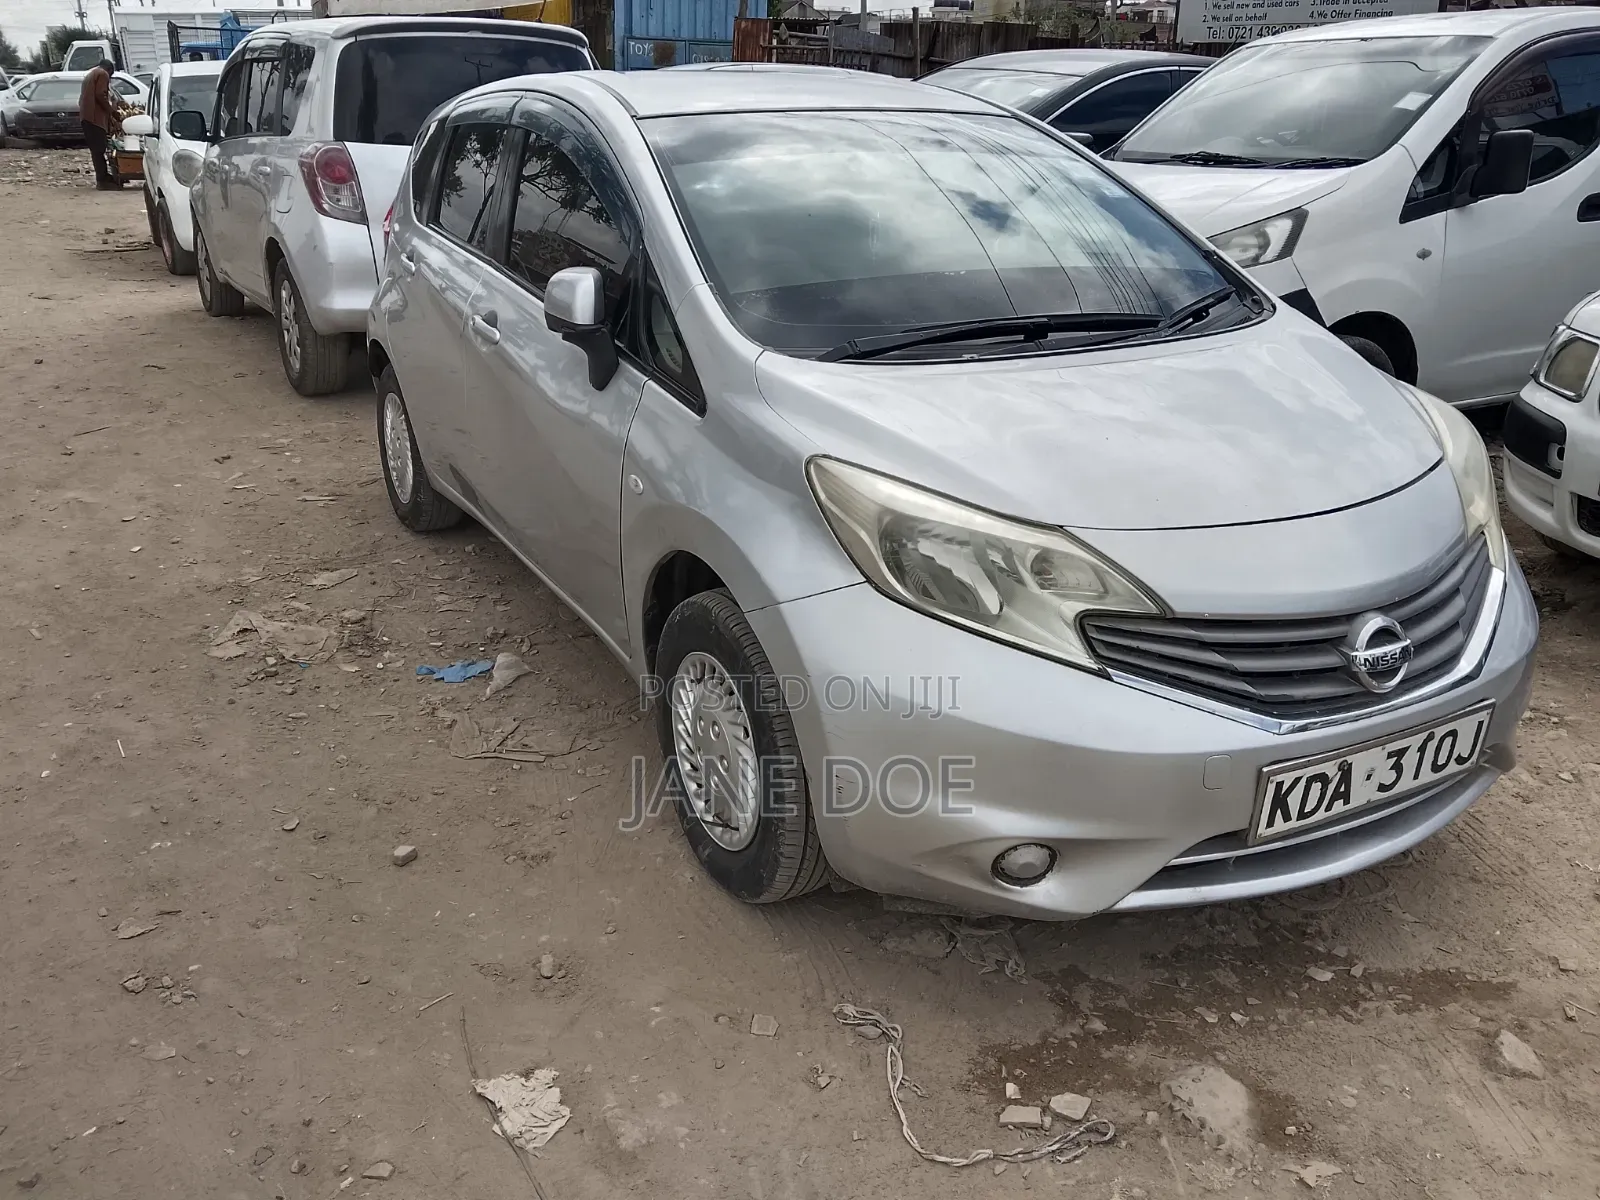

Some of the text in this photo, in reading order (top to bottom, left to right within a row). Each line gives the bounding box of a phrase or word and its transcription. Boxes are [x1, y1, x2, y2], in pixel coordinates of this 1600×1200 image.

[1212, 1, 1222, 10] We
[1223, 1, 1234, 9] sell
[1252, 0, 1265, 9] and
[1267, 0, 1283, 8] used
[1202, 15, 1210, 23] 2.
[1210, 14, 1221, 23] We
[1222, 14, 1233, 22] sell
[1245, 12, 1268, 22] behalf
[1330, 9, 1351, 19] Offer
[1207, 26, 1225, 40] Tel:
[1228, 26, 1253, 40] 0721
[1363, 644, 1413, 669] NISSAN
[1264, 719, 1485, 831] KDA 310J
